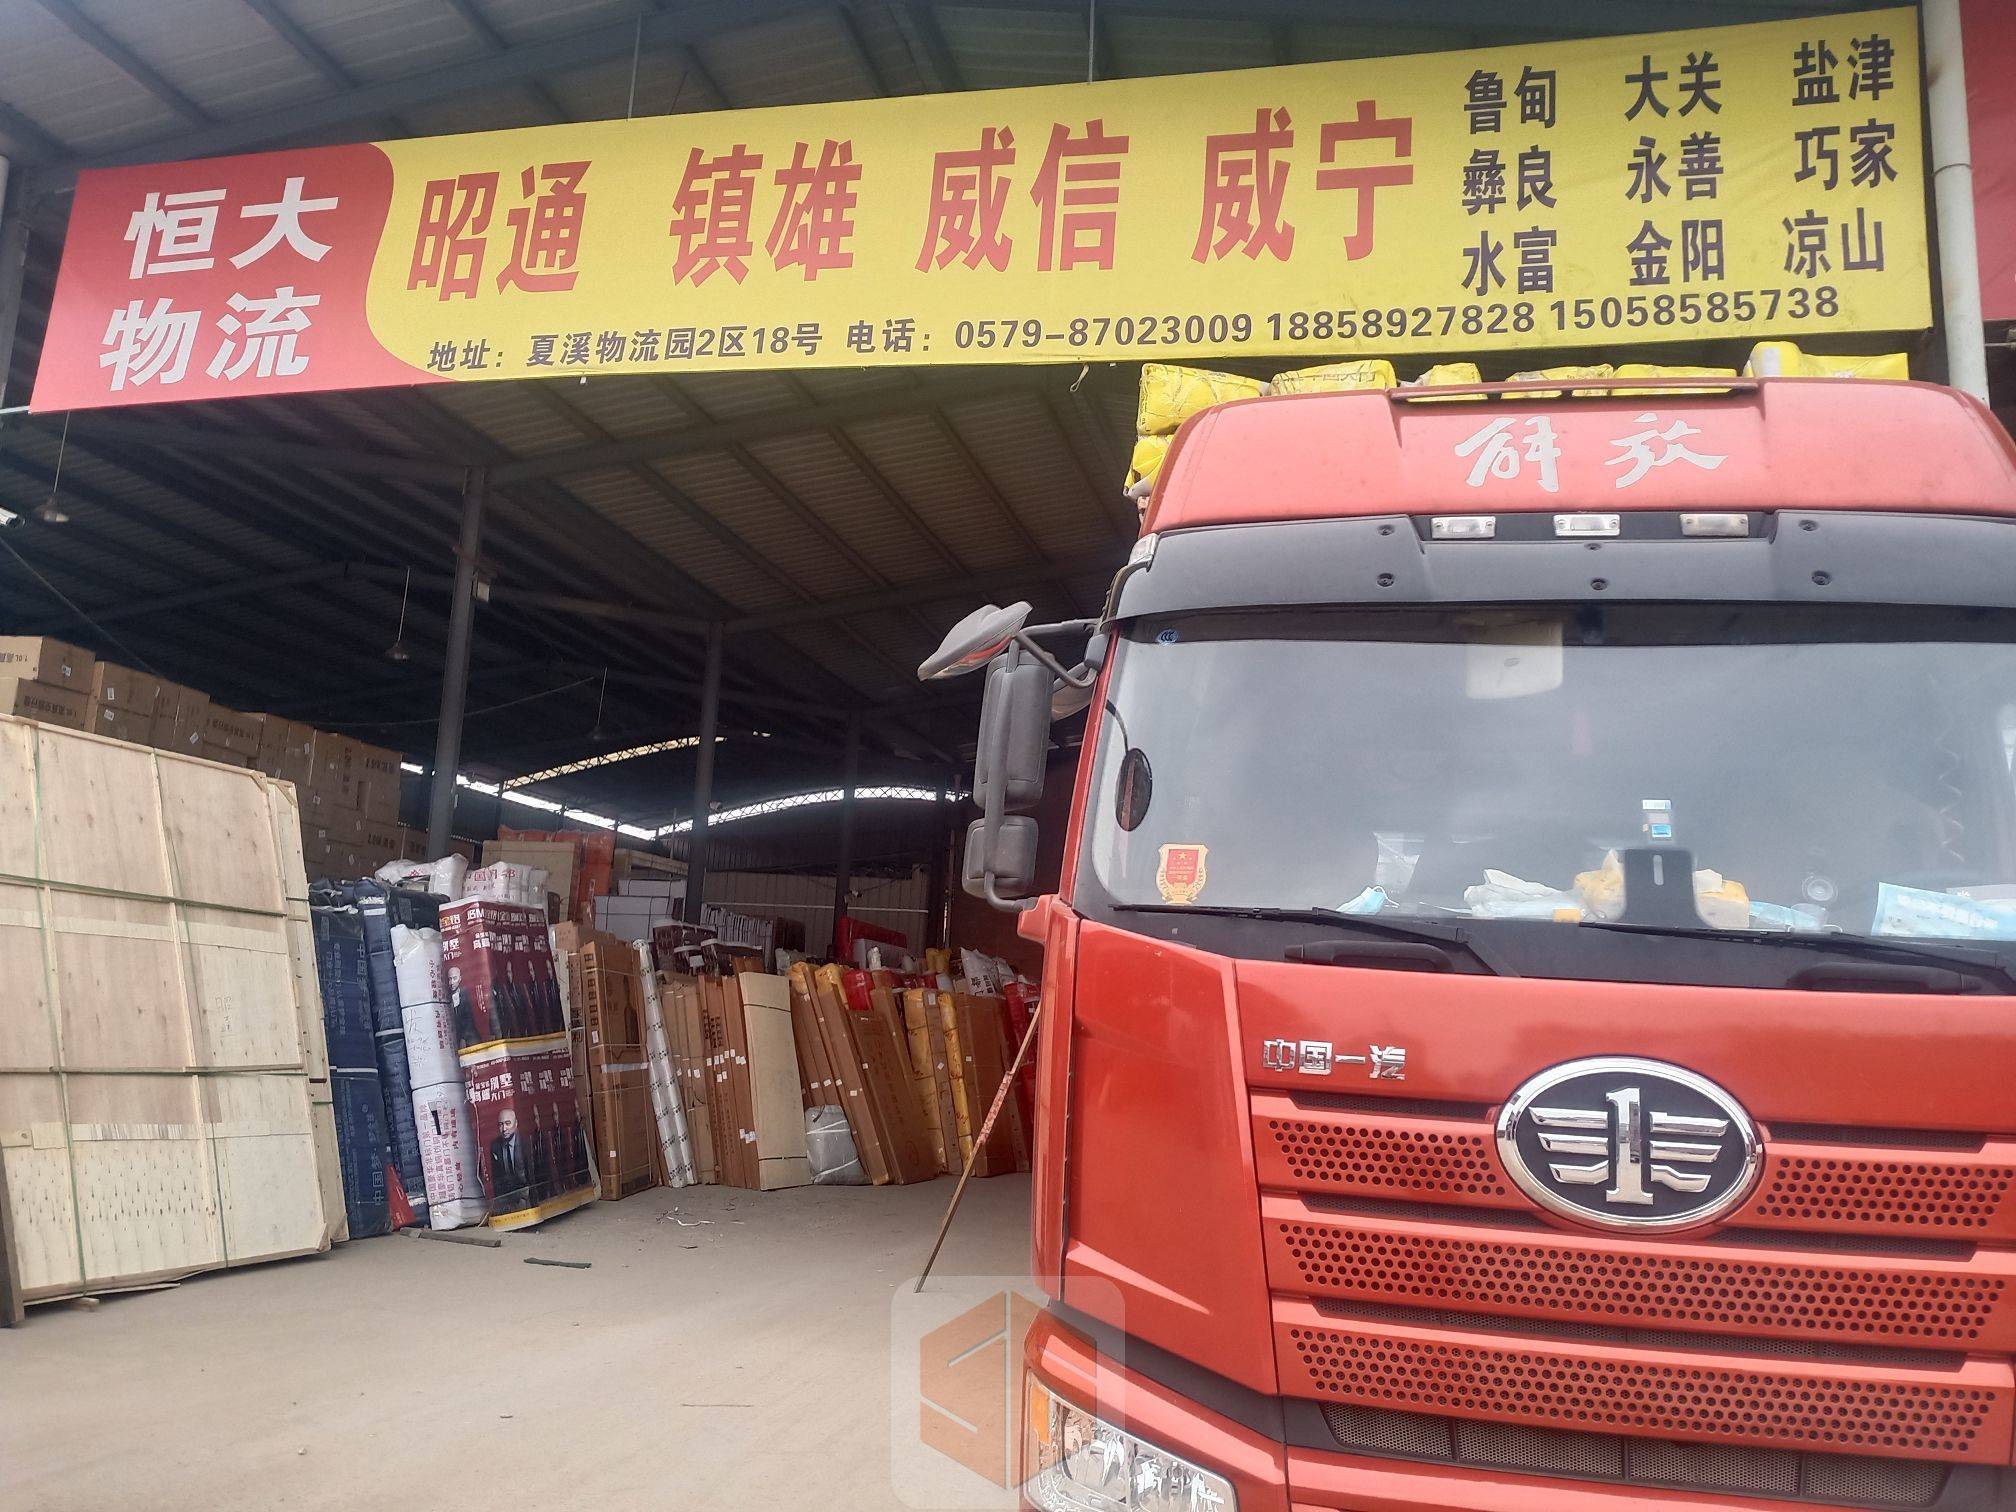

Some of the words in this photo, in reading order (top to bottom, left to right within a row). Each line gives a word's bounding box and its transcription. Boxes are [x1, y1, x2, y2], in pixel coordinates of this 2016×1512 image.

[1464, 65, 1557, 135] 鲁甸
[1624, 50, 1722, 119] 大关
[1792, 33, 1896, 107] 盐津
[407, 160, 593, 302] 昭通
[669, 138, 863, 287] 镇雄
[914, 118, 1131, 273] 威信
[1191, 99, 1415, 264] 威宁
[1462, 145, 1558, 216] 彝良
[1625, 130, 1725, 203] 永善
[1793, 118, 1898, 191] 巧家
[124, 176, 339, 280] 恒大
[1461, 225, 1558, 297] 水富
[1625, 219, 1725, 287] 金阳
[1782, 207, 1885, 279] 凉山
[100, 286, 321, 391] 物流
[526, 322, 823, 368] 夏溪物流园2区18号
[955, 313, 1252, 349] 0579-87023009
[1266, 301, 1535, 342] 18858927828
[1549, 285, 1840, 332] 15058585738
[1263, 1038, 1406, 1081] 中国一汽
